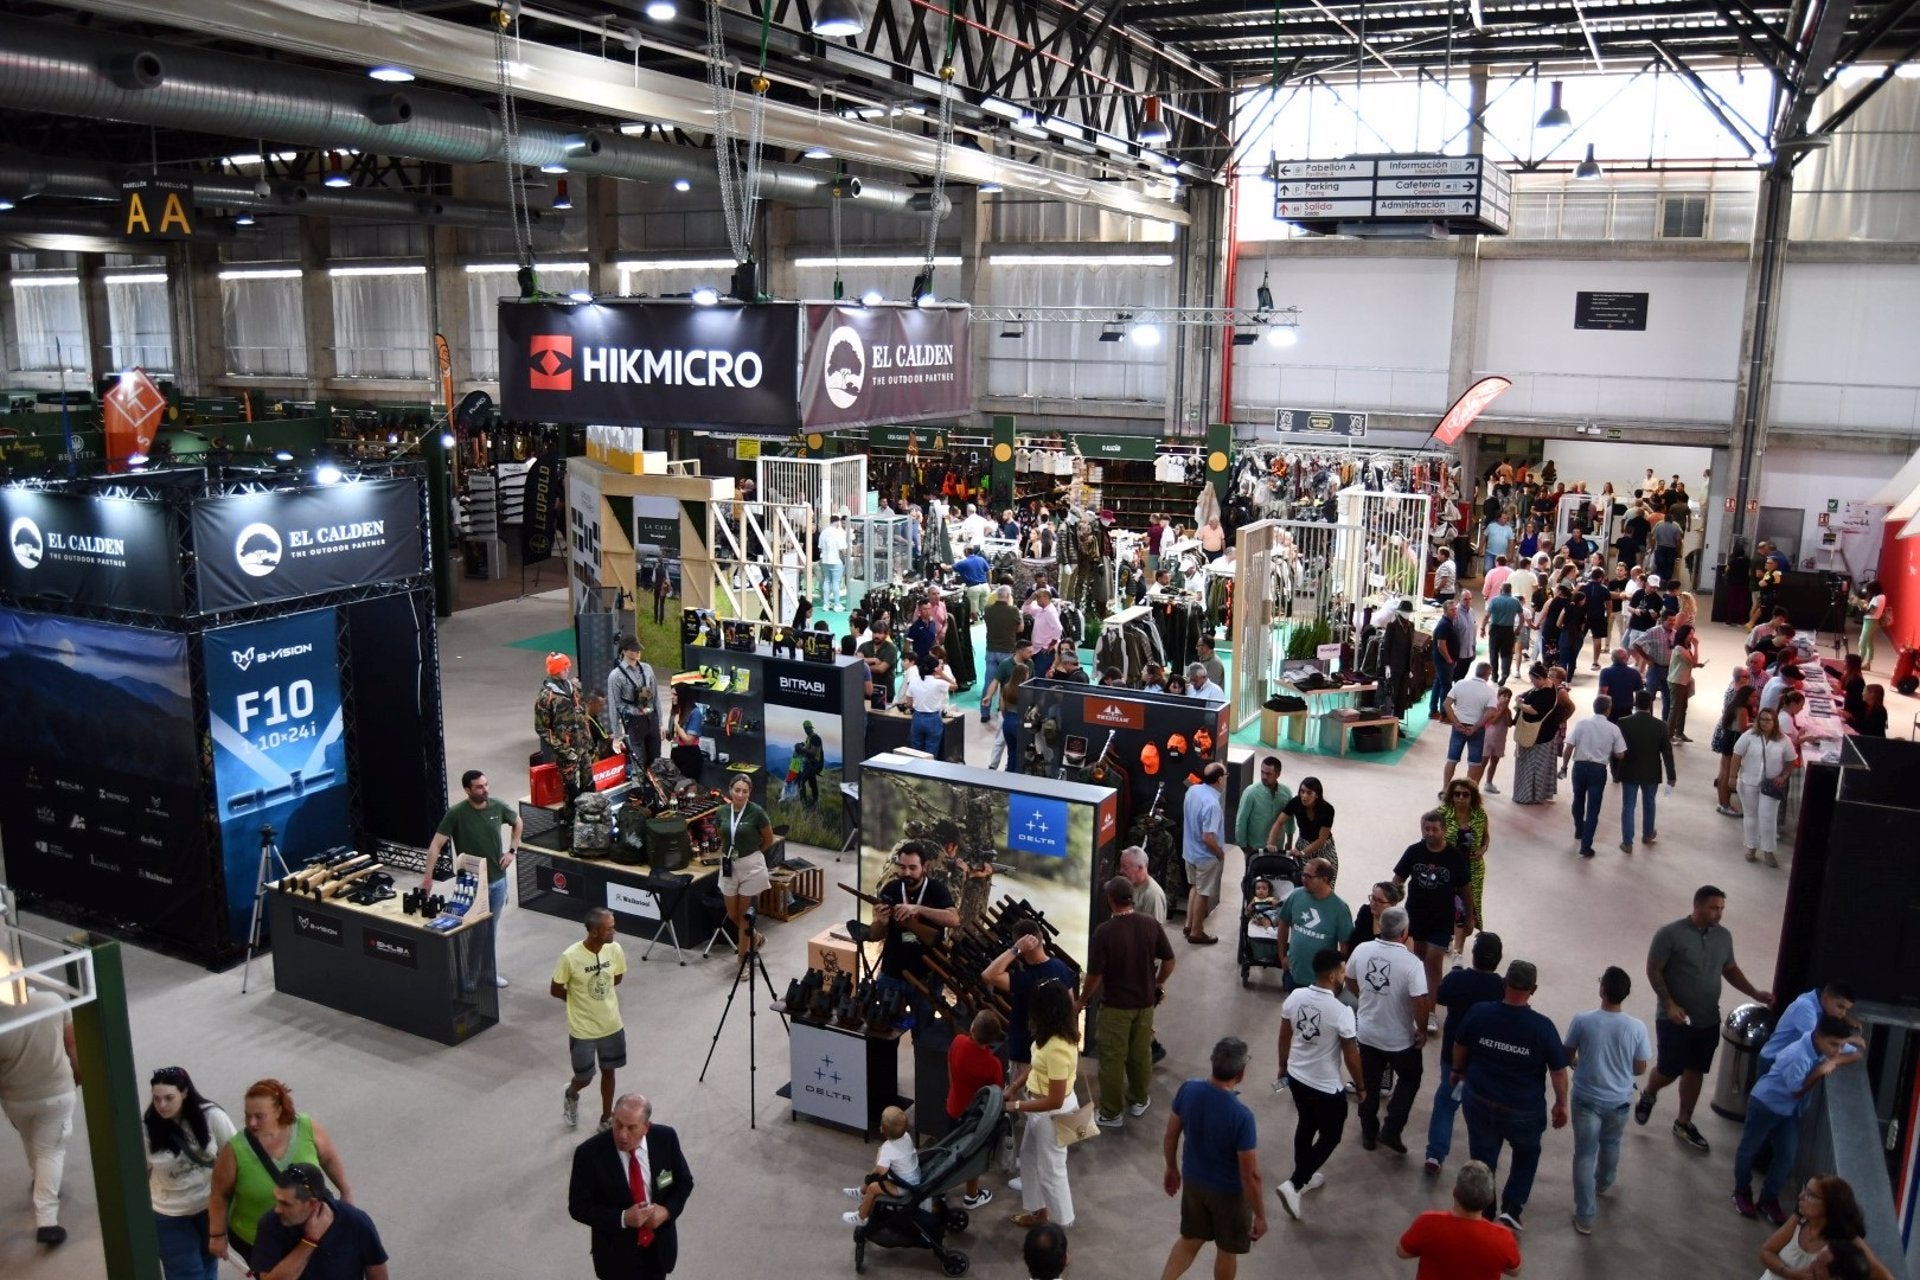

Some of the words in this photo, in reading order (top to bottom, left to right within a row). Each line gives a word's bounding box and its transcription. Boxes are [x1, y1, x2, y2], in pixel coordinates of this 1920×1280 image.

[1306, 161, 1346, 172] Pabellón
[1389, 160, 1448, 169] Información
[1305, 182, 1339, 191] Parking
[1304, 202, 1333, 211] Salida
[1380, 200, 1446, 209] Administración
[126, 192, 151, 235] A
[160, 192, 192, 235] A
[872, 345, 892, 369] EL
[896, 344, 954, 368] CALDEN
[583, 347, 763, 389] HIKMICRO
[872, 376, 886, 386] THE
[888, 375, 923, 385] OUTDOOR
[925, 373, 954, 383] PARTNER
[535, 465, 550, 531] LEUPOLD
[289, 530, 314, 548] EL
[317, 519, 385, 544] CALDEN
[47, 533, 66, 550] EL
[69, 534, 125, 556] CALDEN
[291, 550, 307, 559] THE
[310, 545, 350, 556] OUTDOOR
[352, 539, 386, 550] PARTNER
[50, 553, 62, 561] THE
[64, 554, 95, 564] OUTDOOR
[97, 558, 127, 568] PARTNER
[779, 676, 826, 693] BITRABI
[236, 679, 314, 734] F10
[1018, 833, 1056, 846] DELTA
[1479, 1037, 1494, 1047] JUEZ
[805, 1084, 852, 1102] DELTA
